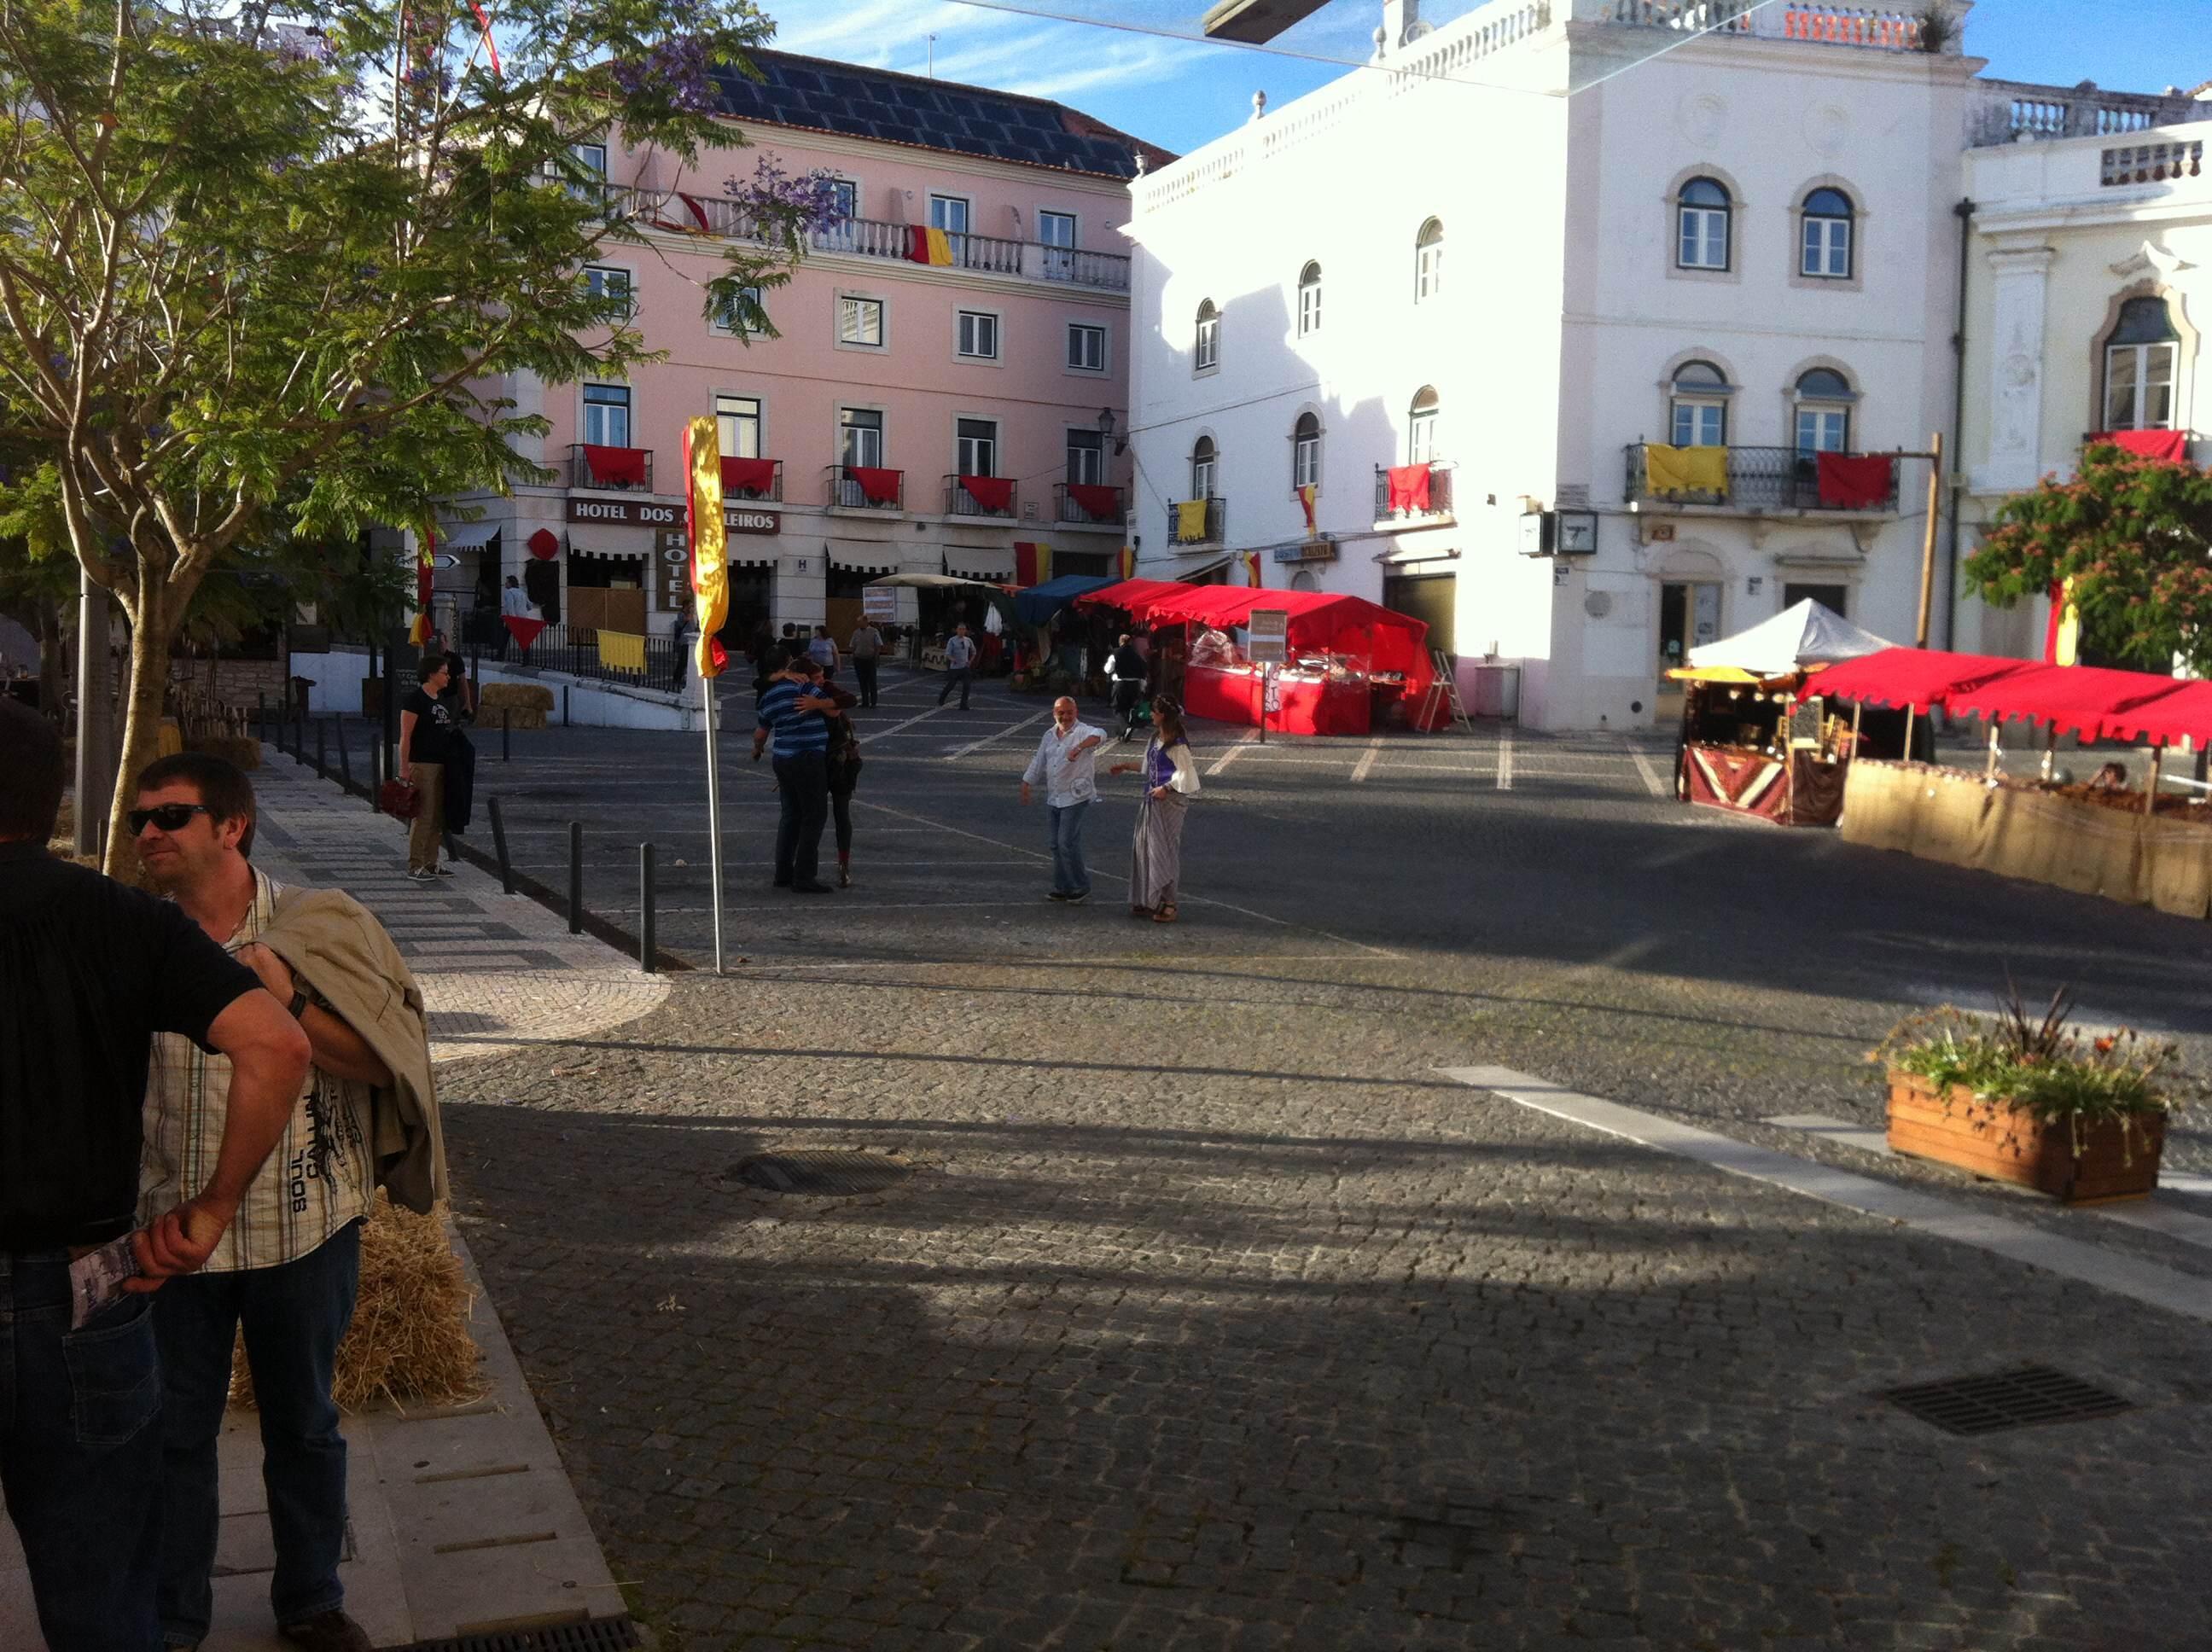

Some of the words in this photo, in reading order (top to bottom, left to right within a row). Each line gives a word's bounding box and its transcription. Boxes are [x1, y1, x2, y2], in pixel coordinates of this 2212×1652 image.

[576, 503, 627, 520] HOTEL
[640, 507, 674, 521] DOS
[684, 509, 774, 529] LEIROS
[664, 533, 688, 608] HOTEL
[799, 560, 806, 568] H
[291, 1149, 306, 1213] SOUL
